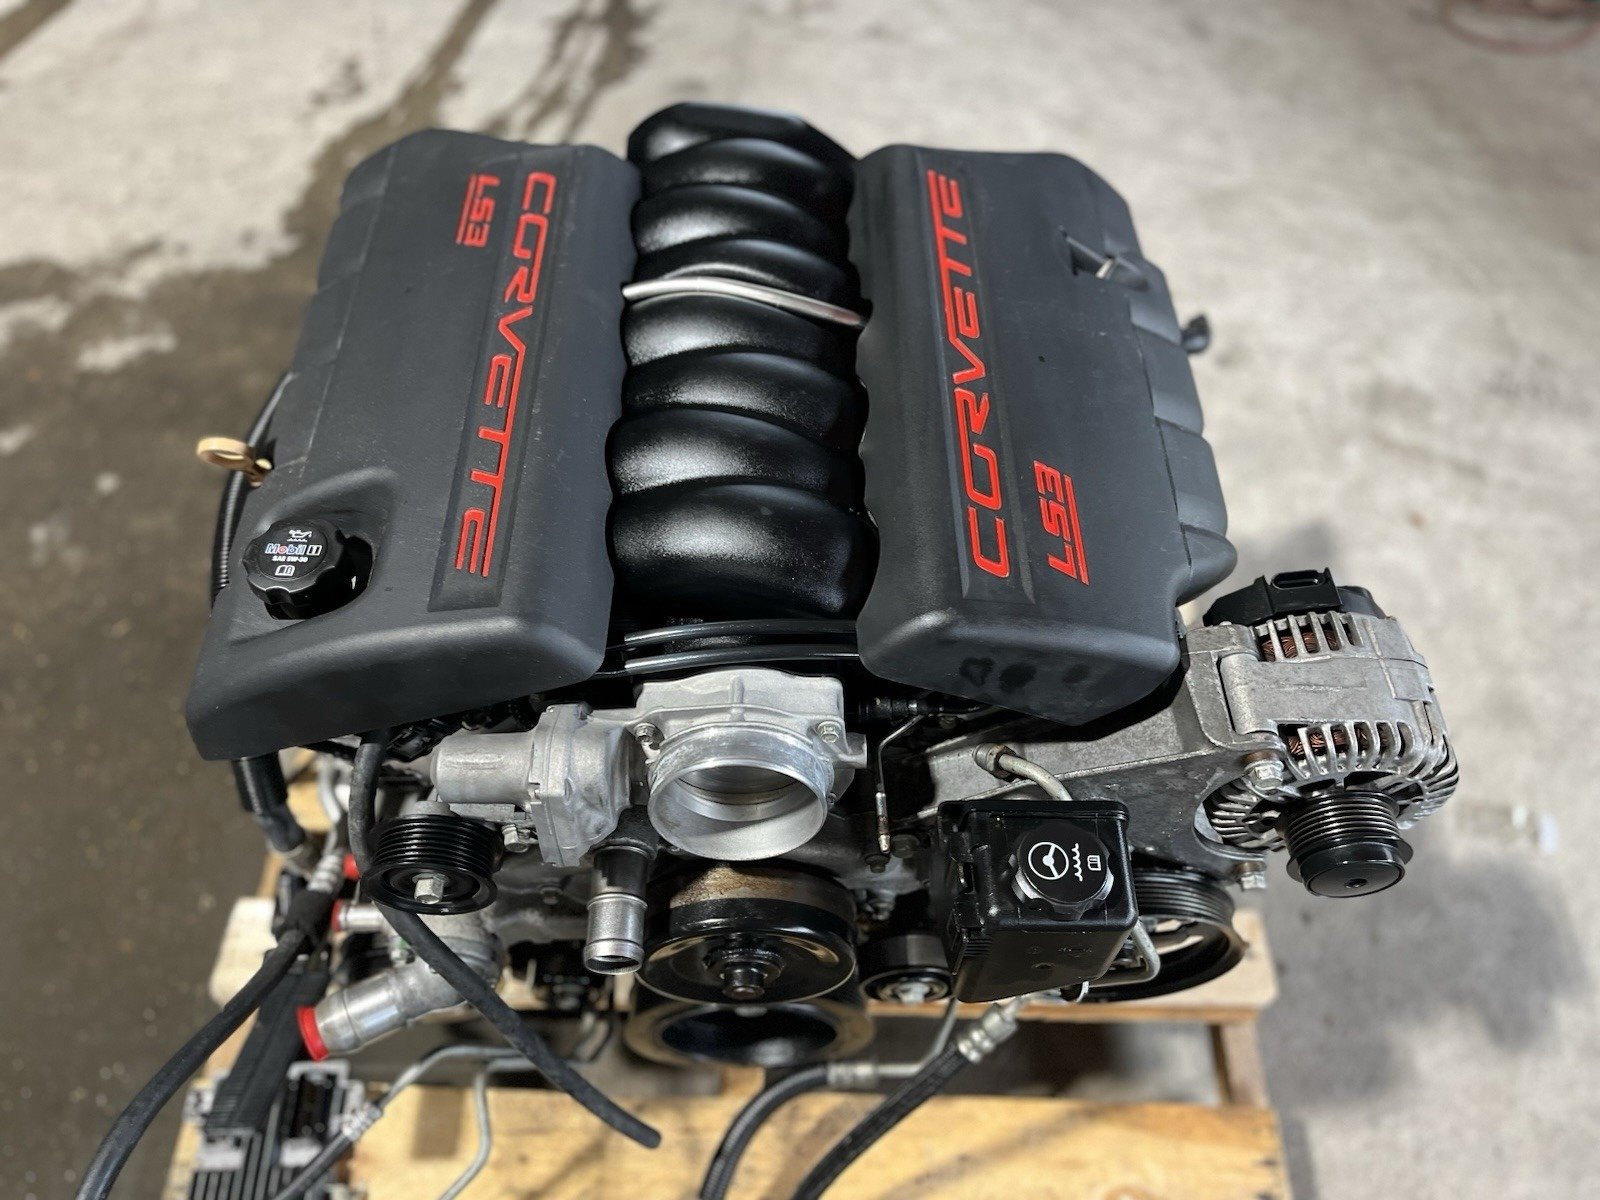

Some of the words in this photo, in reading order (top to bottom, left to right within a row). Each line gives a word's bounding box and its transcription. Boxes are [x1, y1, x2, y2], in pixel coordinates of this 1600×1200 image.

[459, 174, 500, 247] LS3
[455, 171, 557, 577] CORVETTE
[927, 170, 1010, 578] CORVETTE
[265, 543, 306, 554] Mobil
[1034, 460, 1087, 584] LS3
